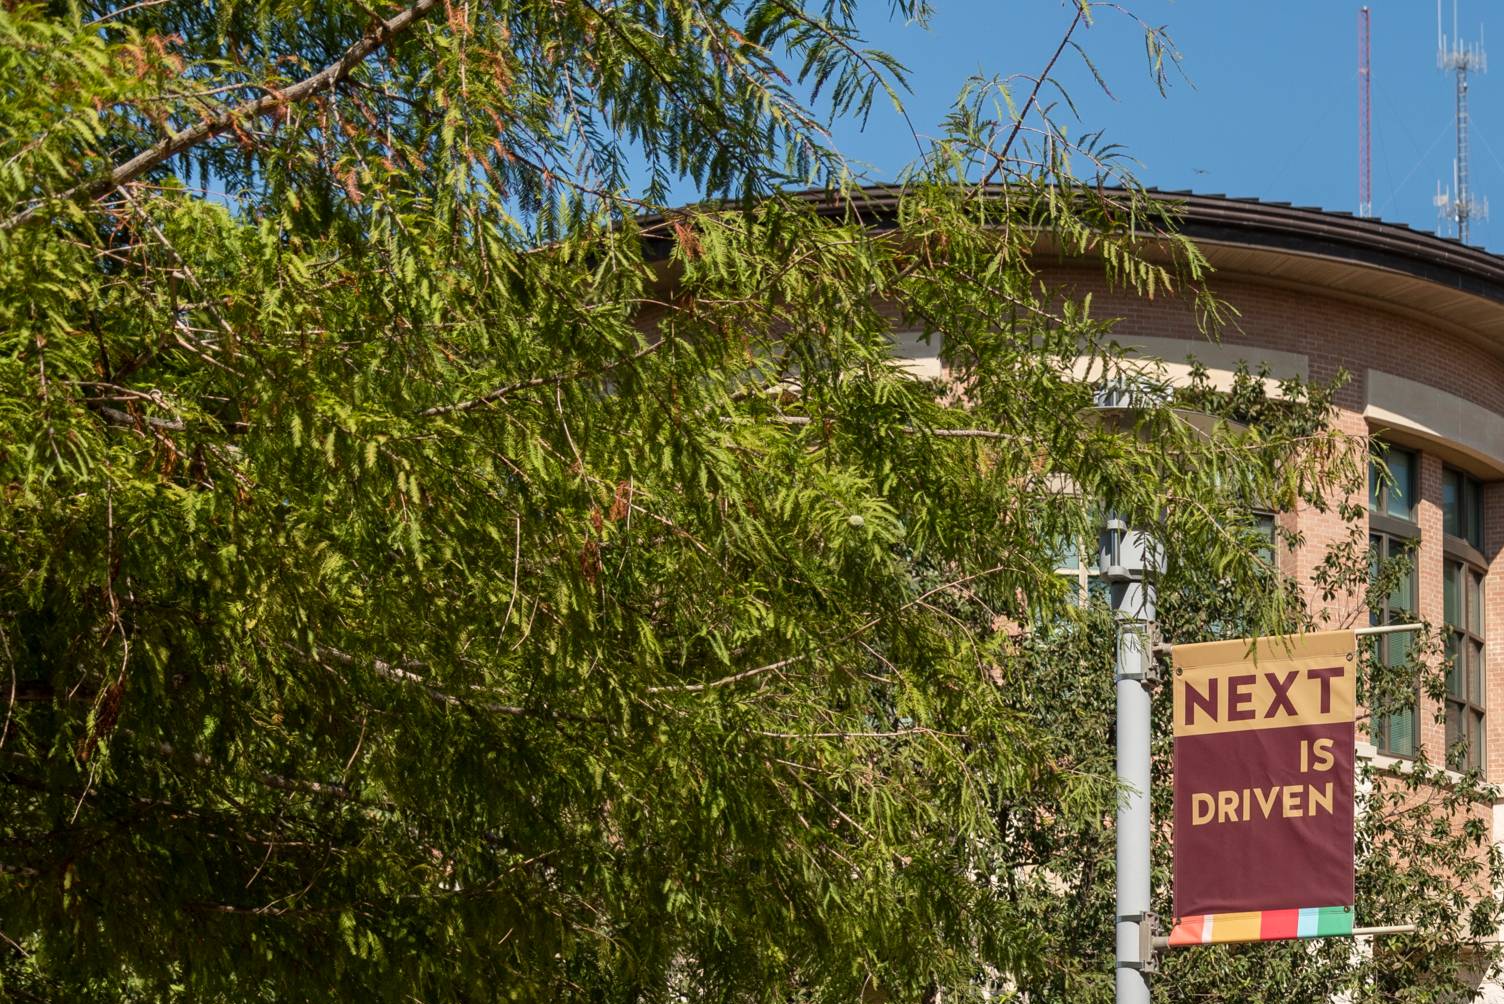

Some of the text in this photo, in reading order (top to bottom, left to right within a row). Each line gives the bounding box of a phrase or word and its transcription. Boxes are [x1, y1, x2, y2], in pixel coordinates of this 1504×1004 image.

[1184, 666, 1345, 726] NEXT
[1300, 738, 1334, 773] IS
[1192, 782, 1334, 826] DRIVEN
